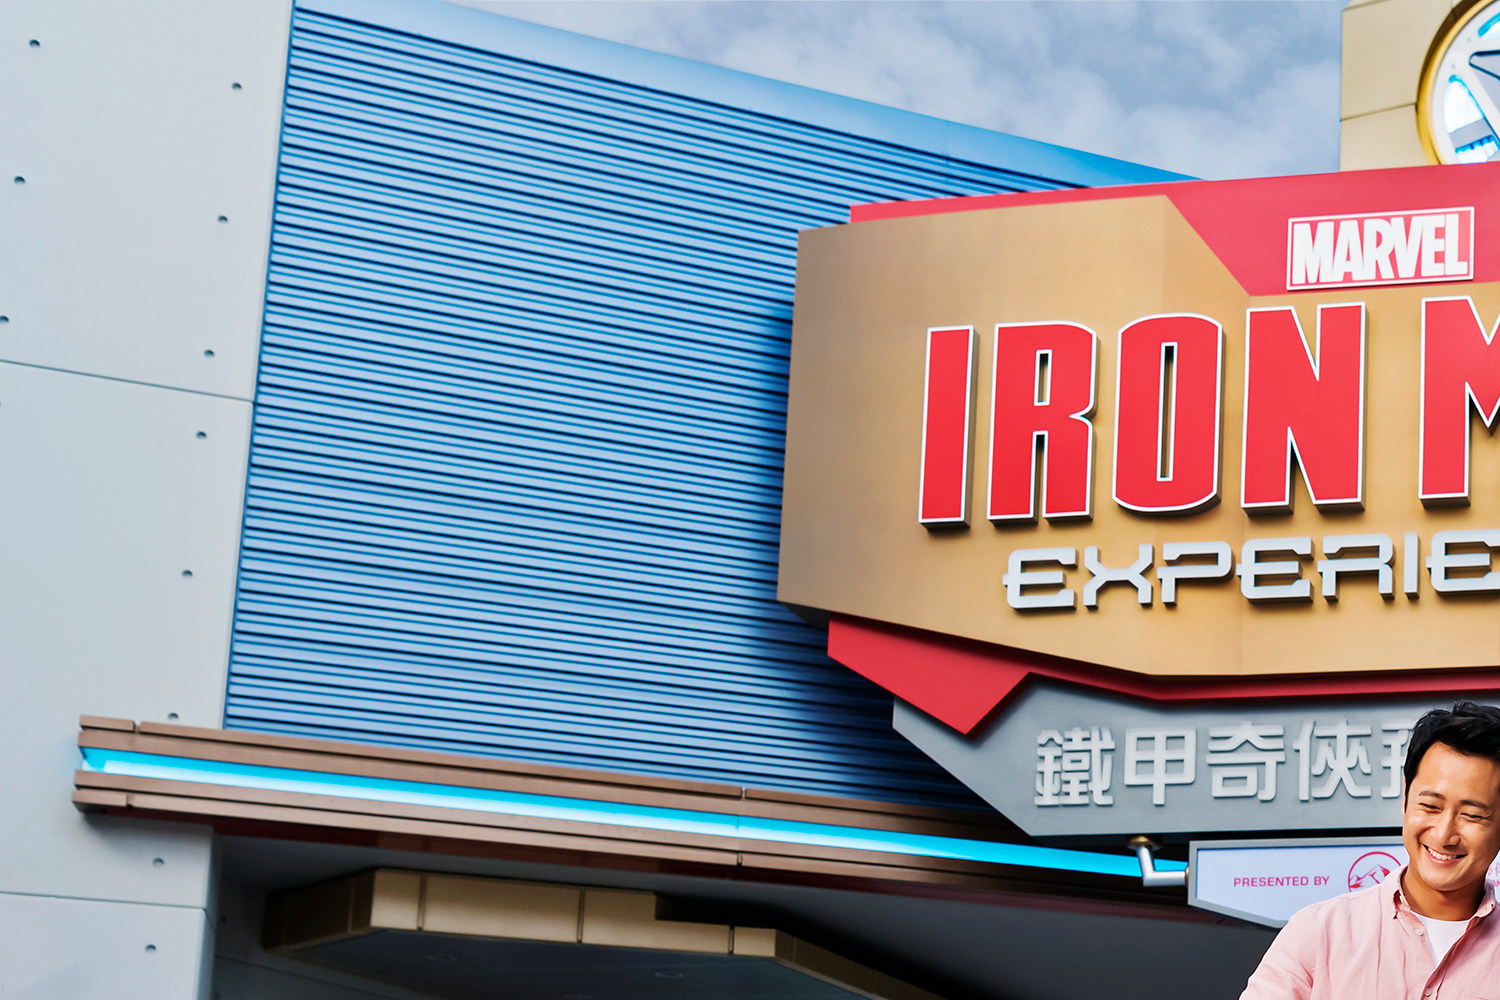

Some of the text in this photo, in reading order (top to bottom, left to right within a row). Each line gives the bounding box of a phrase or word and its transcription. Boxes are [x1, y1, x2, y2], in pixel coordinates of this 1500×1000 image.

[1291, 212, 1468, 286] MARVEL
[918, 302, 1367, 526] IRON
[1233, 875, 1330, 888] PRESENTED BY
